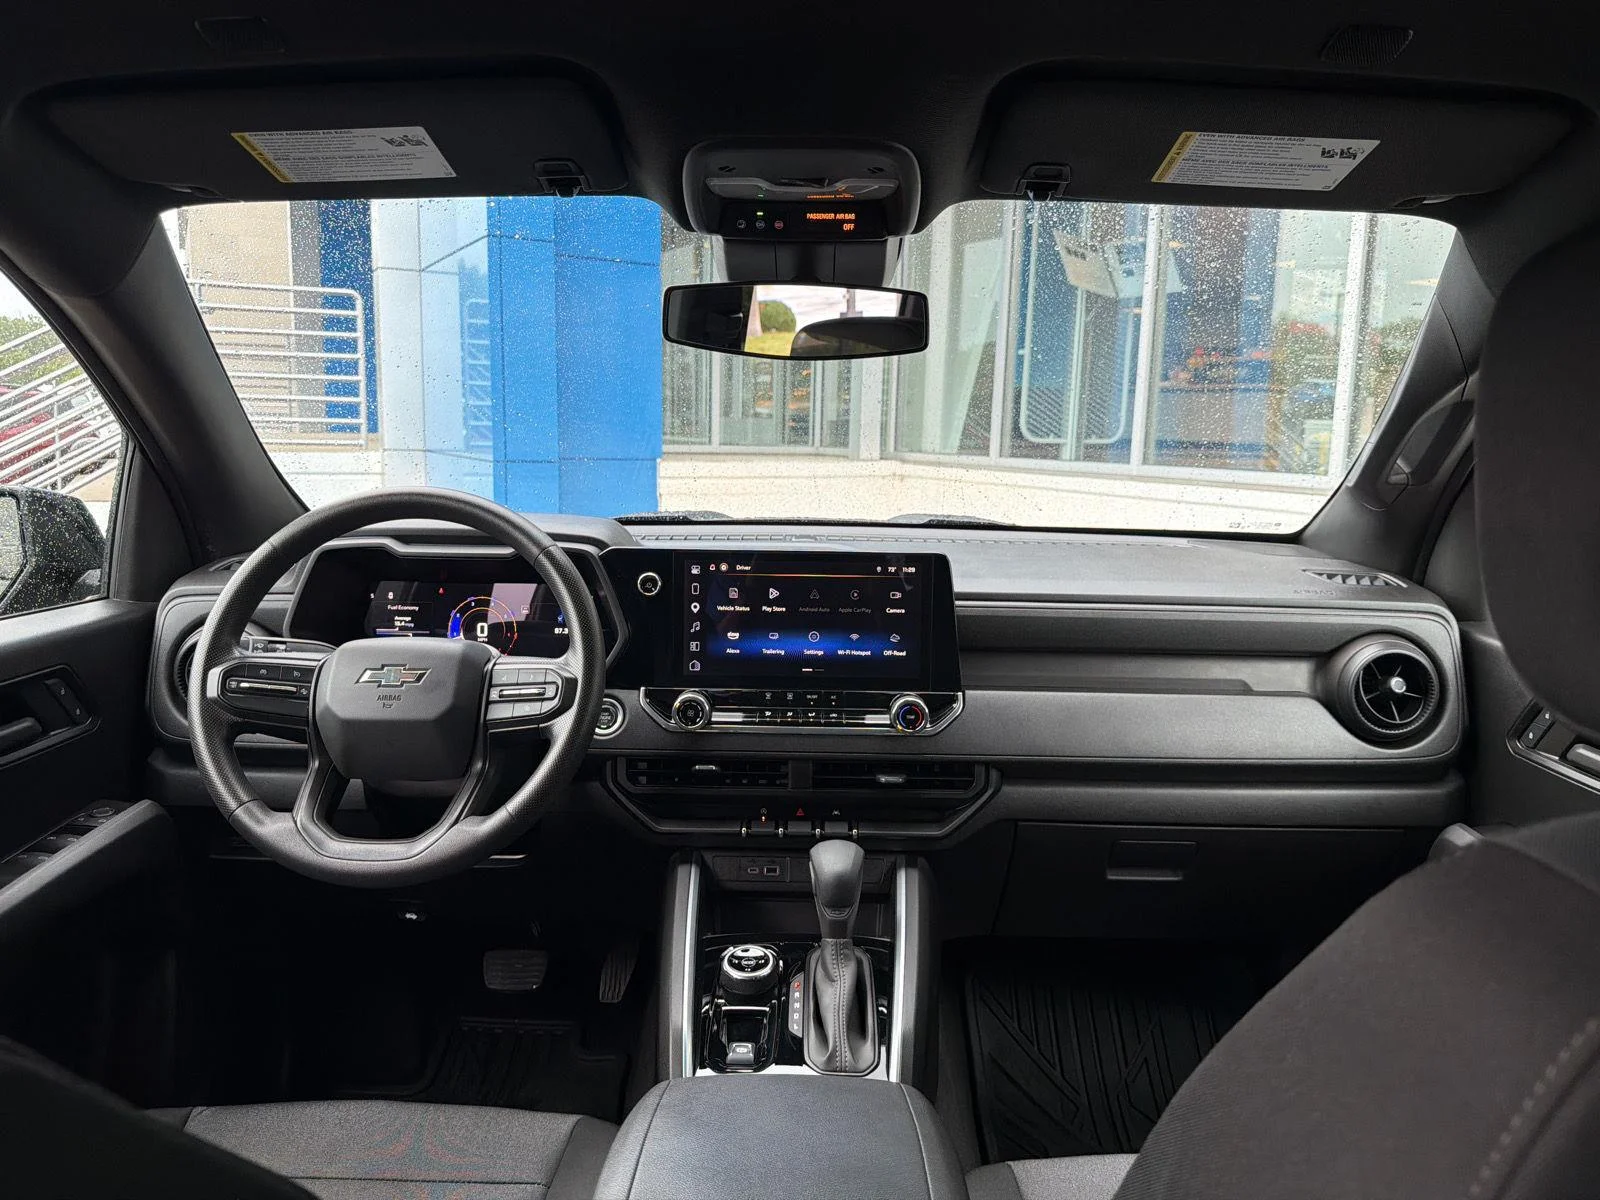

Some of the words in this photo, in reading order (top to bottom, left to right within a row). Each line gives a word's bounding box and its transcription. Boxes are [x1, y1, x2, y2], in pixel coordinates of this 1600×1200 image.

[843, 223, 855, 231] OFF
[398, 604, 419, 612] Economy
[762, 605, 773, 613] Play
[476, 622, 489, 638] 0
[762, 648, 785, 656] Trailering
[851, 649, 872, 657] Hotspot
[376, 694, 402, 702] AIRBAG
